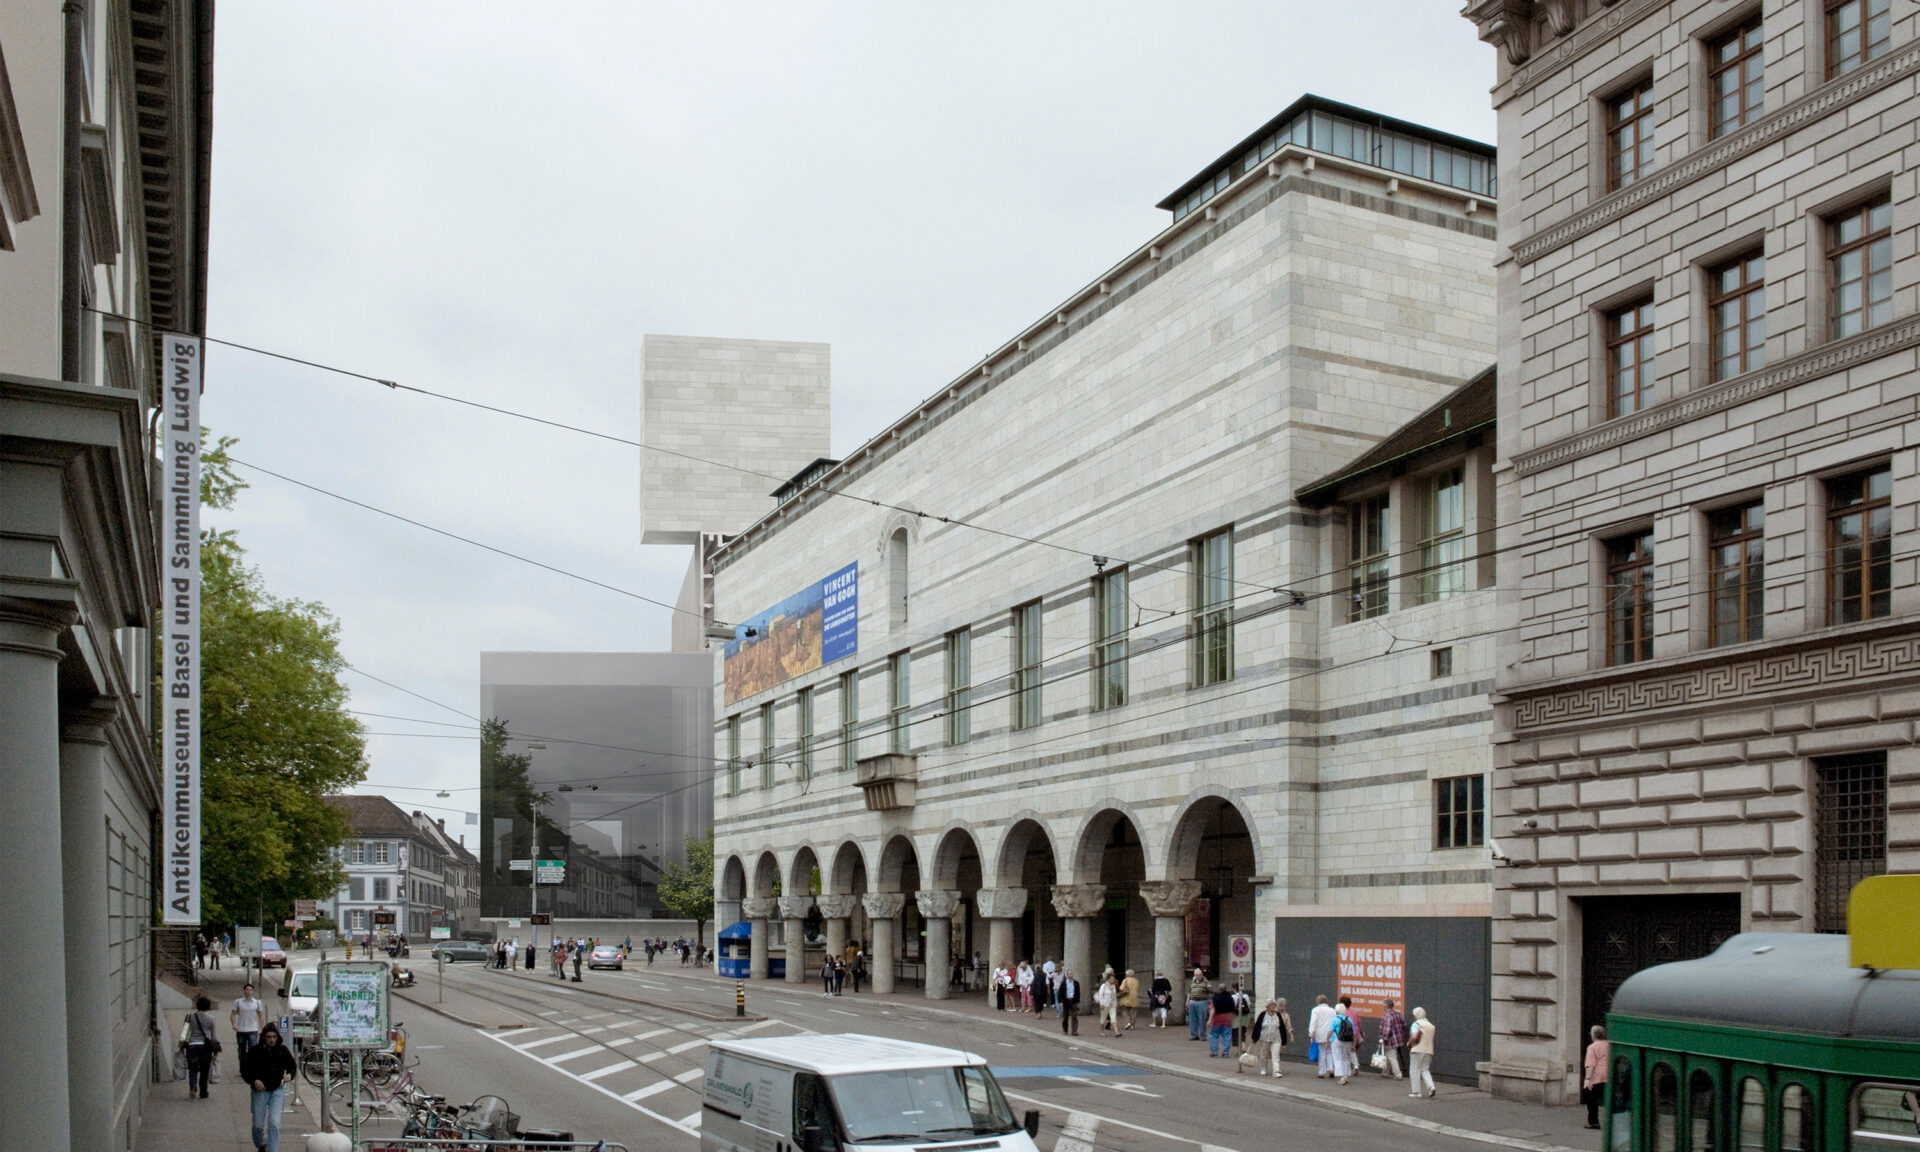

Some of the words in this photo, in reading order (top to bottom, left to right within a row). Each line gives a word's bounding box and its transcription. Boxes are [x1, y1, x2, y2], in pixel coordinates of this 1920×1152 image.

[171, 343, 195, 432] Ludwig
[171, 440, 195, 569] Sammlung
[823, 568, 856, 596] VINCENT
[171, 577, 190, 625] und
[823, 593, 837, 610] VAN
[837, 583, 856, 603] GOGH
[171, 633, 190, 699] Basel
[171, 708, 190, 915] Antikenmuseum
[1340, 947, 1402, 963] VINCENT
[1340, 963, 1364, 978] VAN
[1366, 964, 1402, 979] GOGH
[1341, 986, 1351, 994] DIE
[1352, 987, 1402, 998] LANDSCHAFTEN
[340, 1001, 356, 1012] IVY
